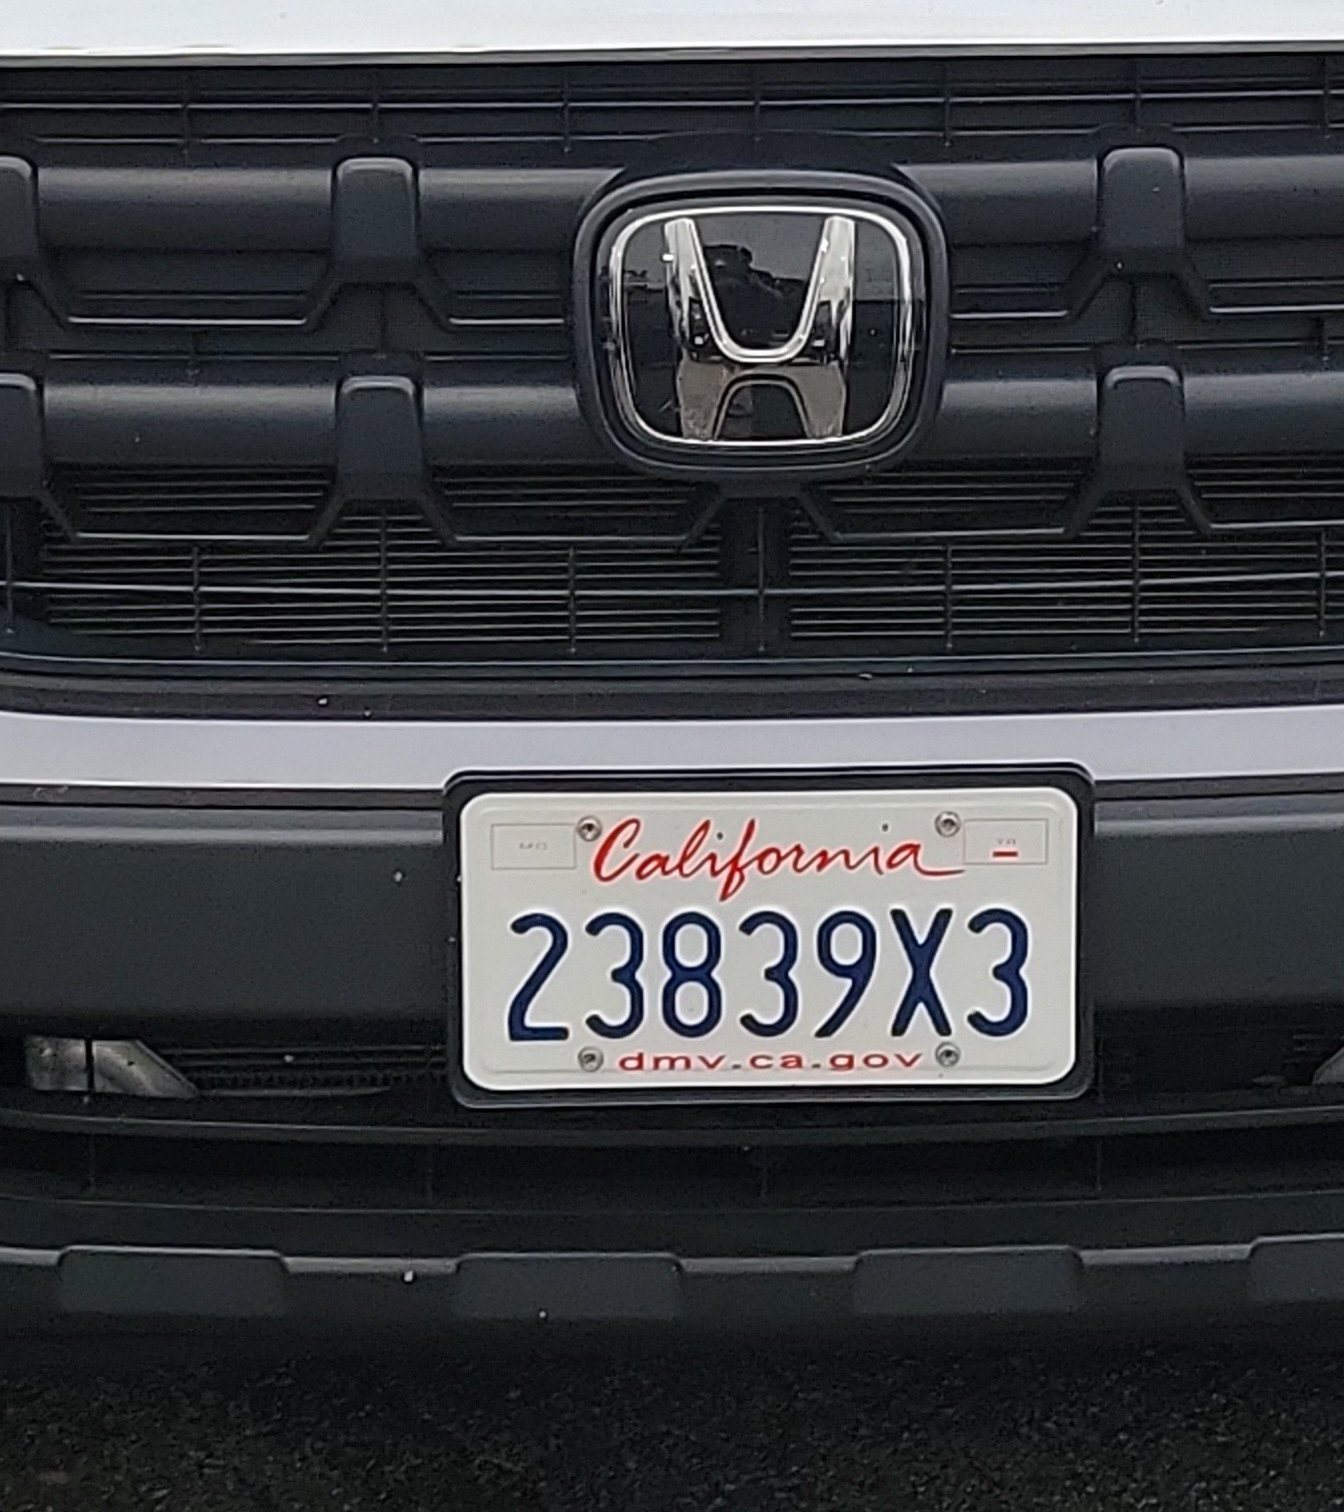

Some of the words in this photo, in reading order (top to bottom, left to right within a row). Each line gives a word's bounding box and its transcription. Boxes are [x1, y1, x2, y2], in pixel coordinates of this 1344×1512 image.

[593, 818, 965, 902] California
[507, 908, 1030, 1041] 23839X3
[618, 1048, 924, 1072] dmv.ca.gov
